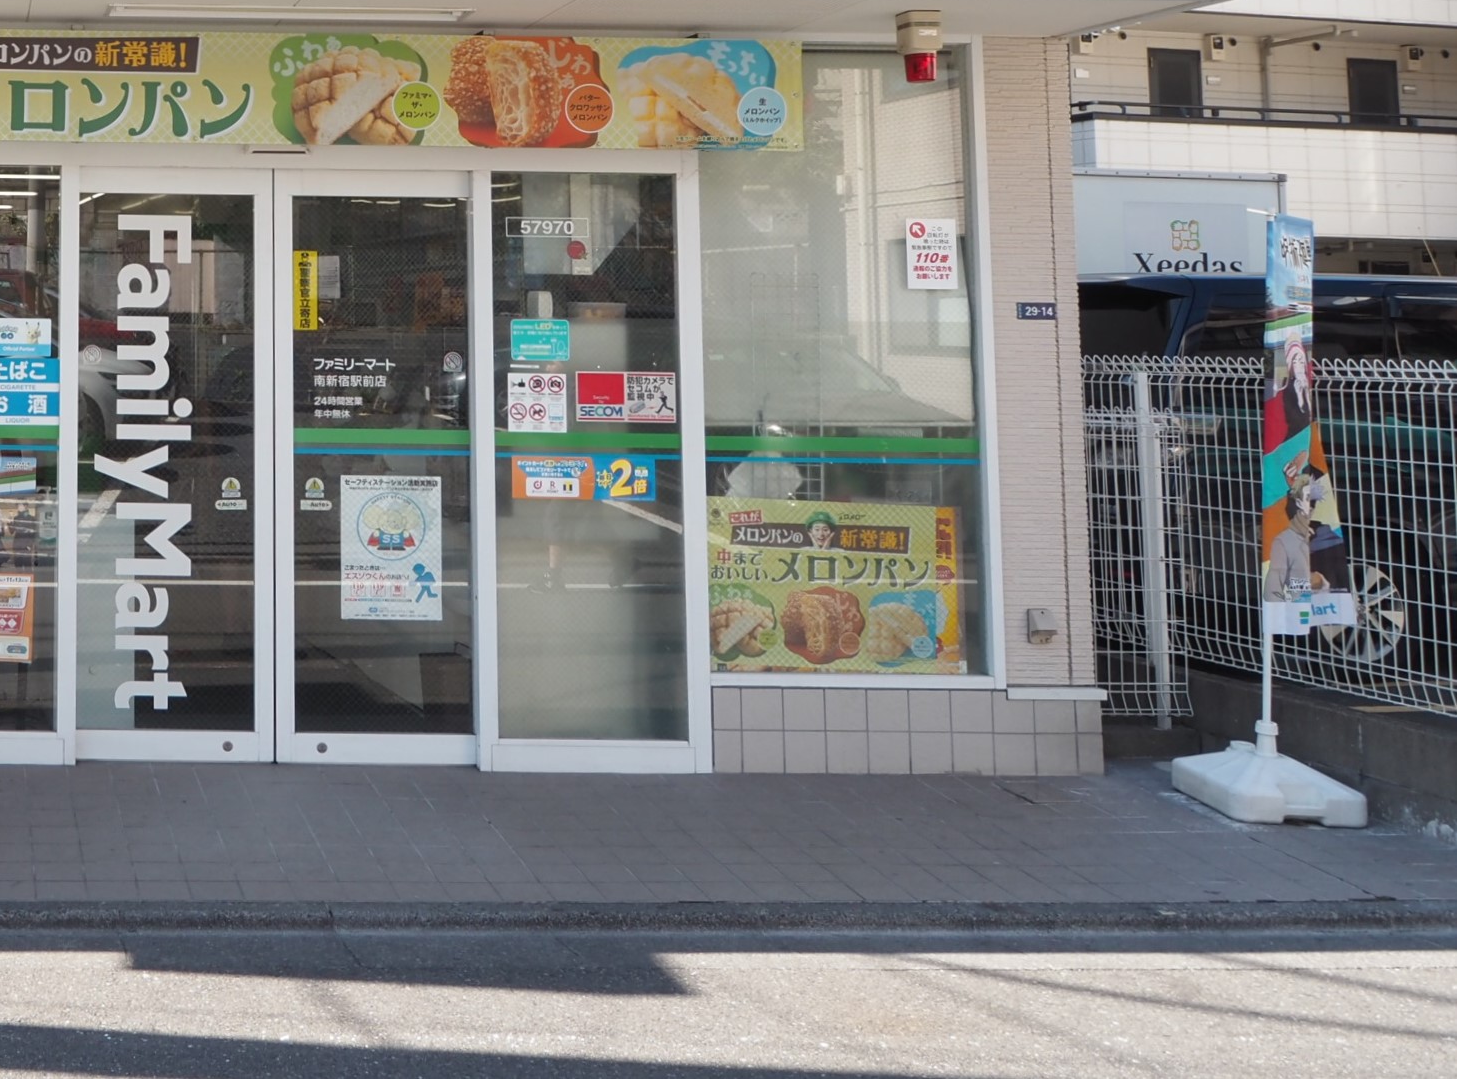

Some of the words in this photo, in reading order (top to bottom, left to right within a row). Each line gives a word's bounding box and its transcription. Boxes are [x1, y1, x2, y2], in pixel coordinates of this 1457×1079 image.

[758, 98, 767, 106] 生
[520, 221, 574, 235] 57970
[916, 252, 949, 263] 110番
[1133, 252, 1243, 272] Xeedas
[299, 267, 311, 329] 警察官立寄店
[1025, 306, 1054, 316] 29-14
[0, 332, 14, 340] GO
[314, 358, 396, 371] ファミリーマート
[314, 375, 386, 387] 南新宿駅前店
[627, 377, 674, 385] 防犯カメラで
[627, 385, 661, 393] セコムが
[314, 396, 363, 406] 24時間営業
[627, 393, 654, 401] 監視中
[28, 395, 47, 414] 酒
[314, 410, 351, 419] 年中無休
[580, 406, 623, 416] SECOM
[94, 215, 192, 710] FamilyMart
[610, 459, 632, 497] 2
[382, 534, 401, 543] SS
[733, 528, 803, 543] メロンパンの
[840, 529, 905, 550] 新常識!
[717, 548, 762, 565] 中まで
[711, 565, 768, 581] おいしい
[772, 553, 930, 588] メロンパン
